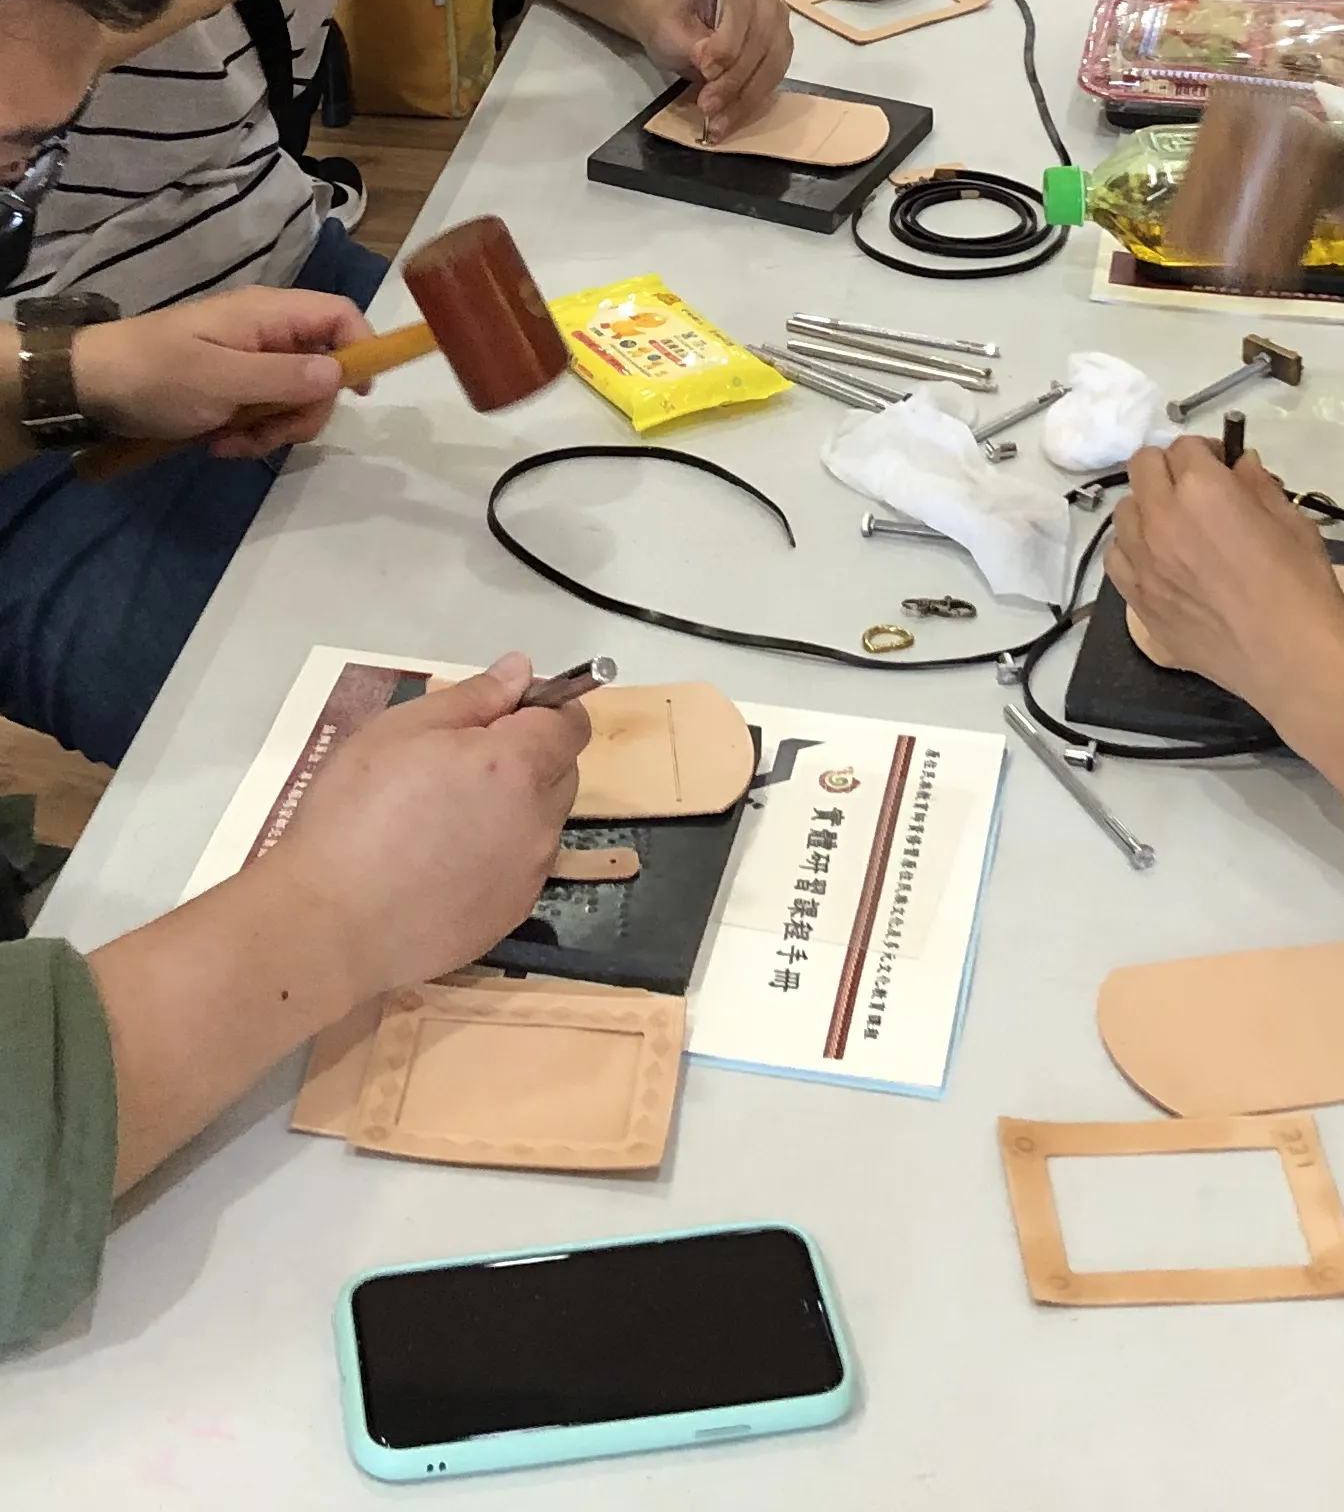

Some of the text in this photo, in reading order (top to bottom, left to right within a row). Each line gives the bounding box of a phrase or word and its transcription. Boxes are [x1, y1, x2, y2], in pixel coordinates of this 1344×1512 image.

[768, 806, 846, 993] 實體研習課程手冊
